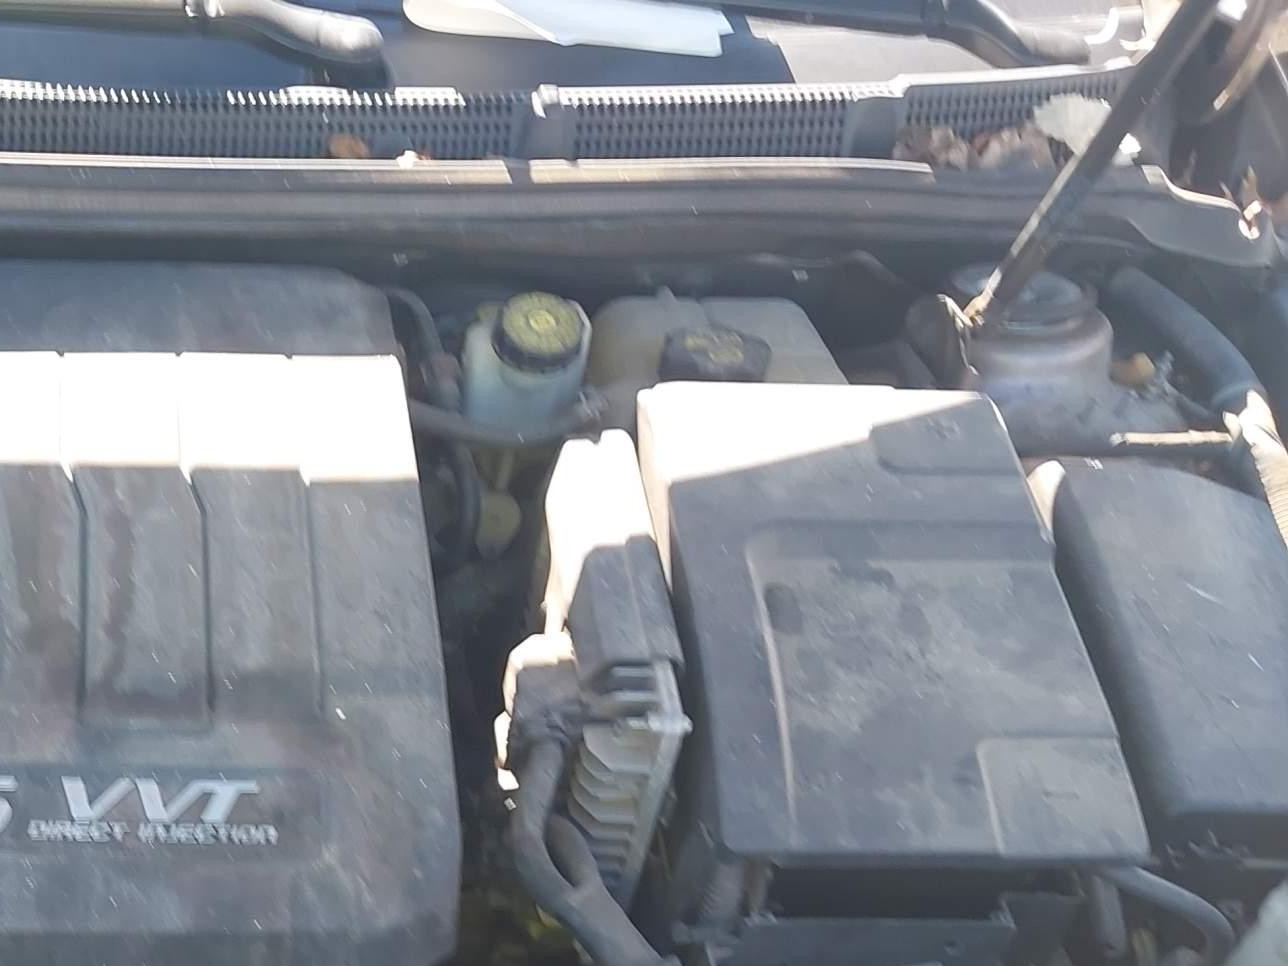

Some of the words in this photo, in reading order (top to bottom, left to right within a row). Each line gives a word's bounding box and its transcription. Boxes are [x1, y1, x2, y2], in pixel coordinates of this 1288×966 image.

[61, 775, 259, 824] VVT
[27, 819, 130, 842] DIRECT
[137, 822, 279, 845] INJECTION
